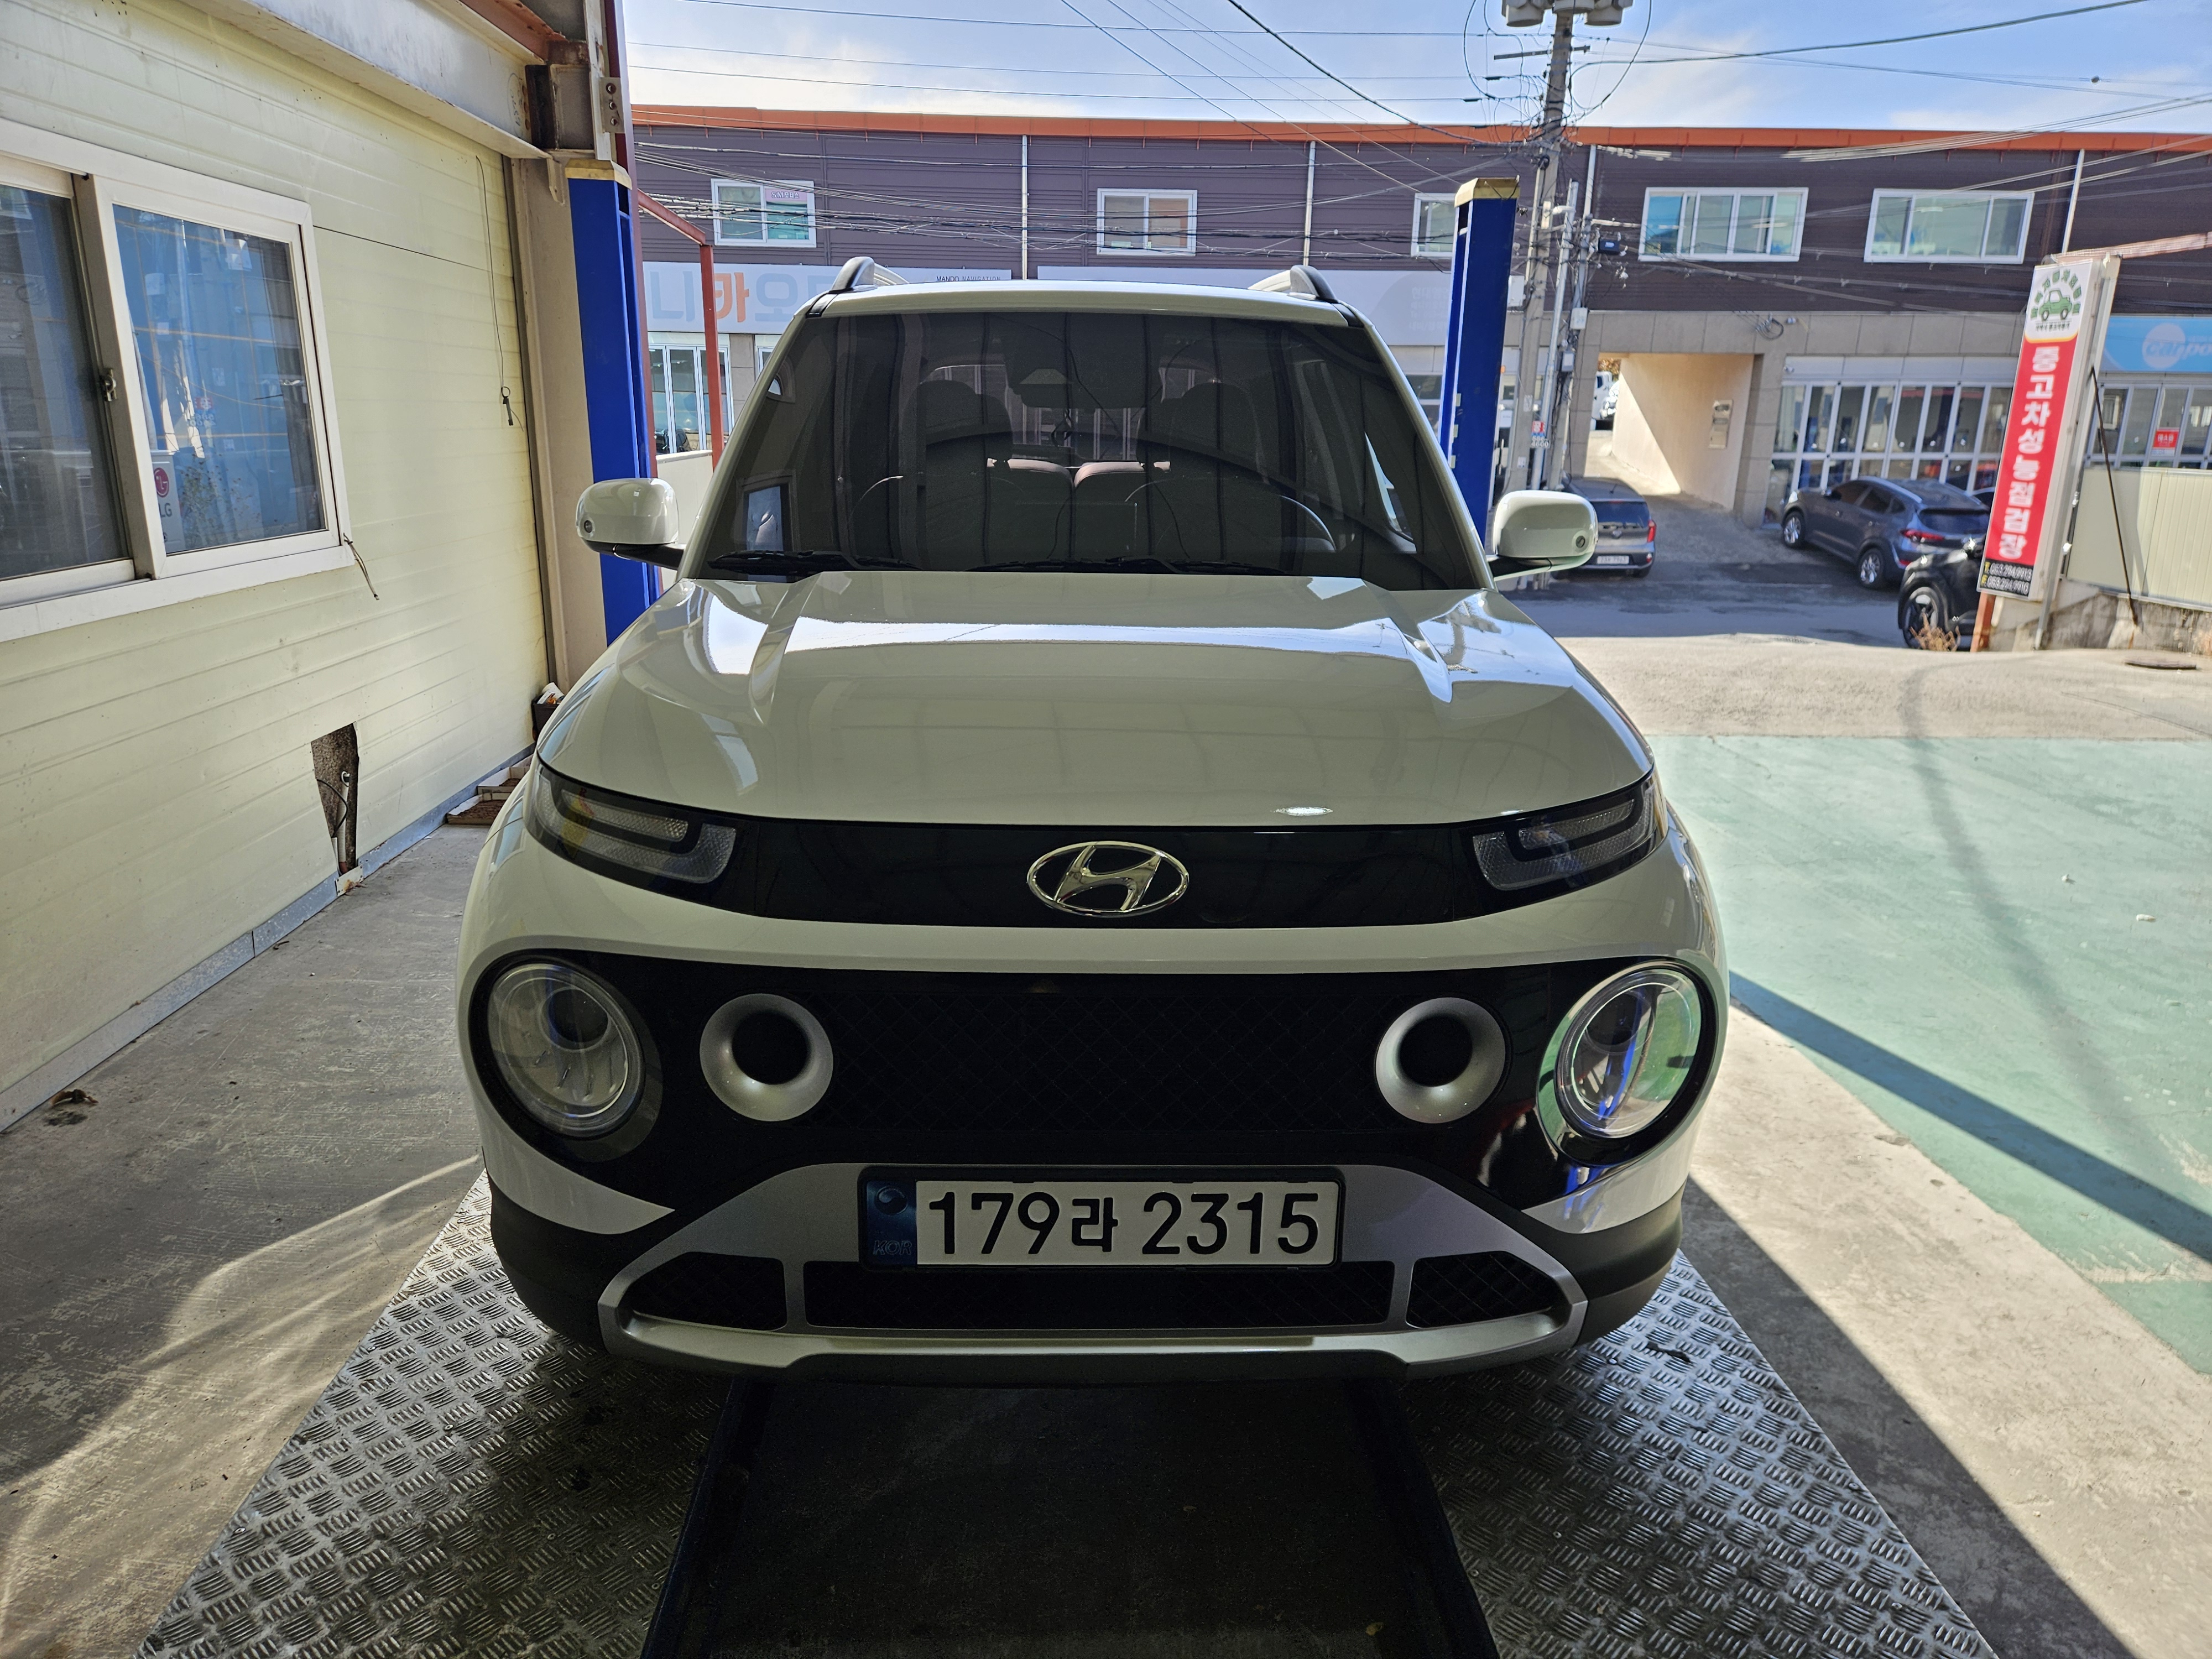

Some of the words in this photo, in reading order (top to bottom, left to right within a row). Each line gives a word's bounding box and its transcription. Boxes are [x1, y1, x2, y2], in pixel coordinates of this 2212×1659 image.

[929, 1192, 1119, 1255] 179라
[1142, 1191, 1319, 1255] 2315
[873, 1240, 912, 1255] KOR
